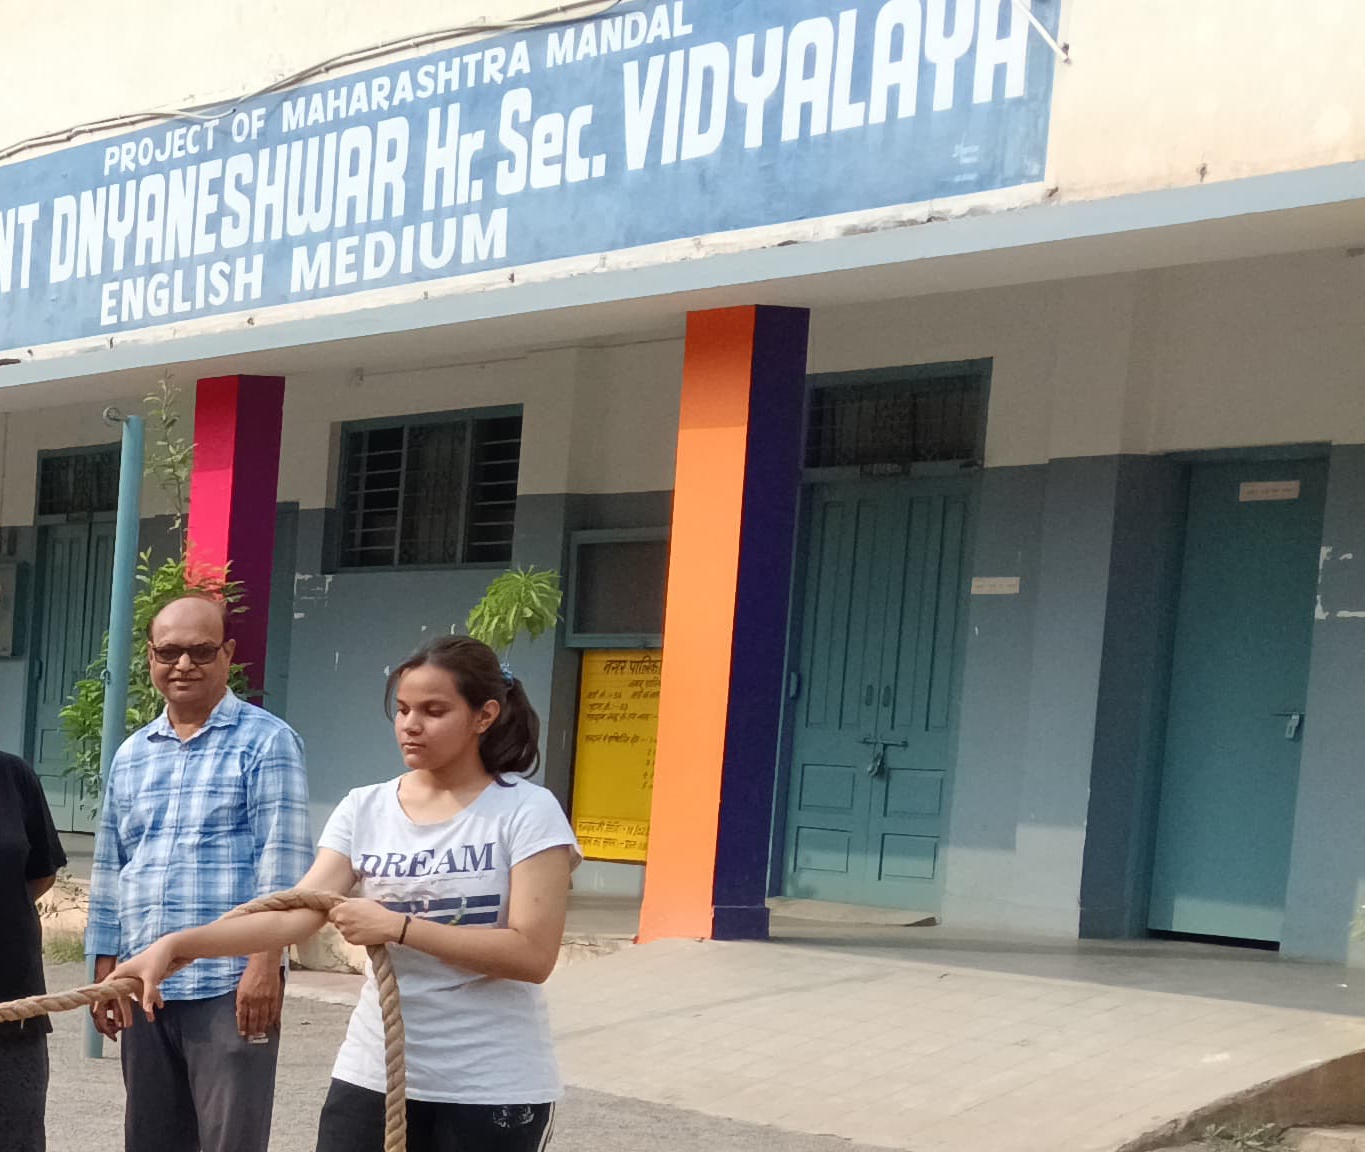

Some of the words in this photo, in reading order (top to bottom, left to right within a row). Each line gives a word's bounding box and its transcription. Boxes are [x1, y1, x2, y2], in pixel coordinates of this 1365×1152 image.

[49, 116, 410, 283] DNYANESHWAR
[495, 87, 607, 196] Sec.
[623, 0, 1029, 172] VIDYALAYA
[104, 119, 220, 176] PROJECT
[231, 107, 267, 144] OF
[281, 40, 531, 133] MAHARASHTRA
[545, 3, 693, 68] MANDAL
[99, 254, 264, 326] ENGLISH
[289, 207, 509, 293] MEDIUM
[360, 841, 498, 879] DREAM
